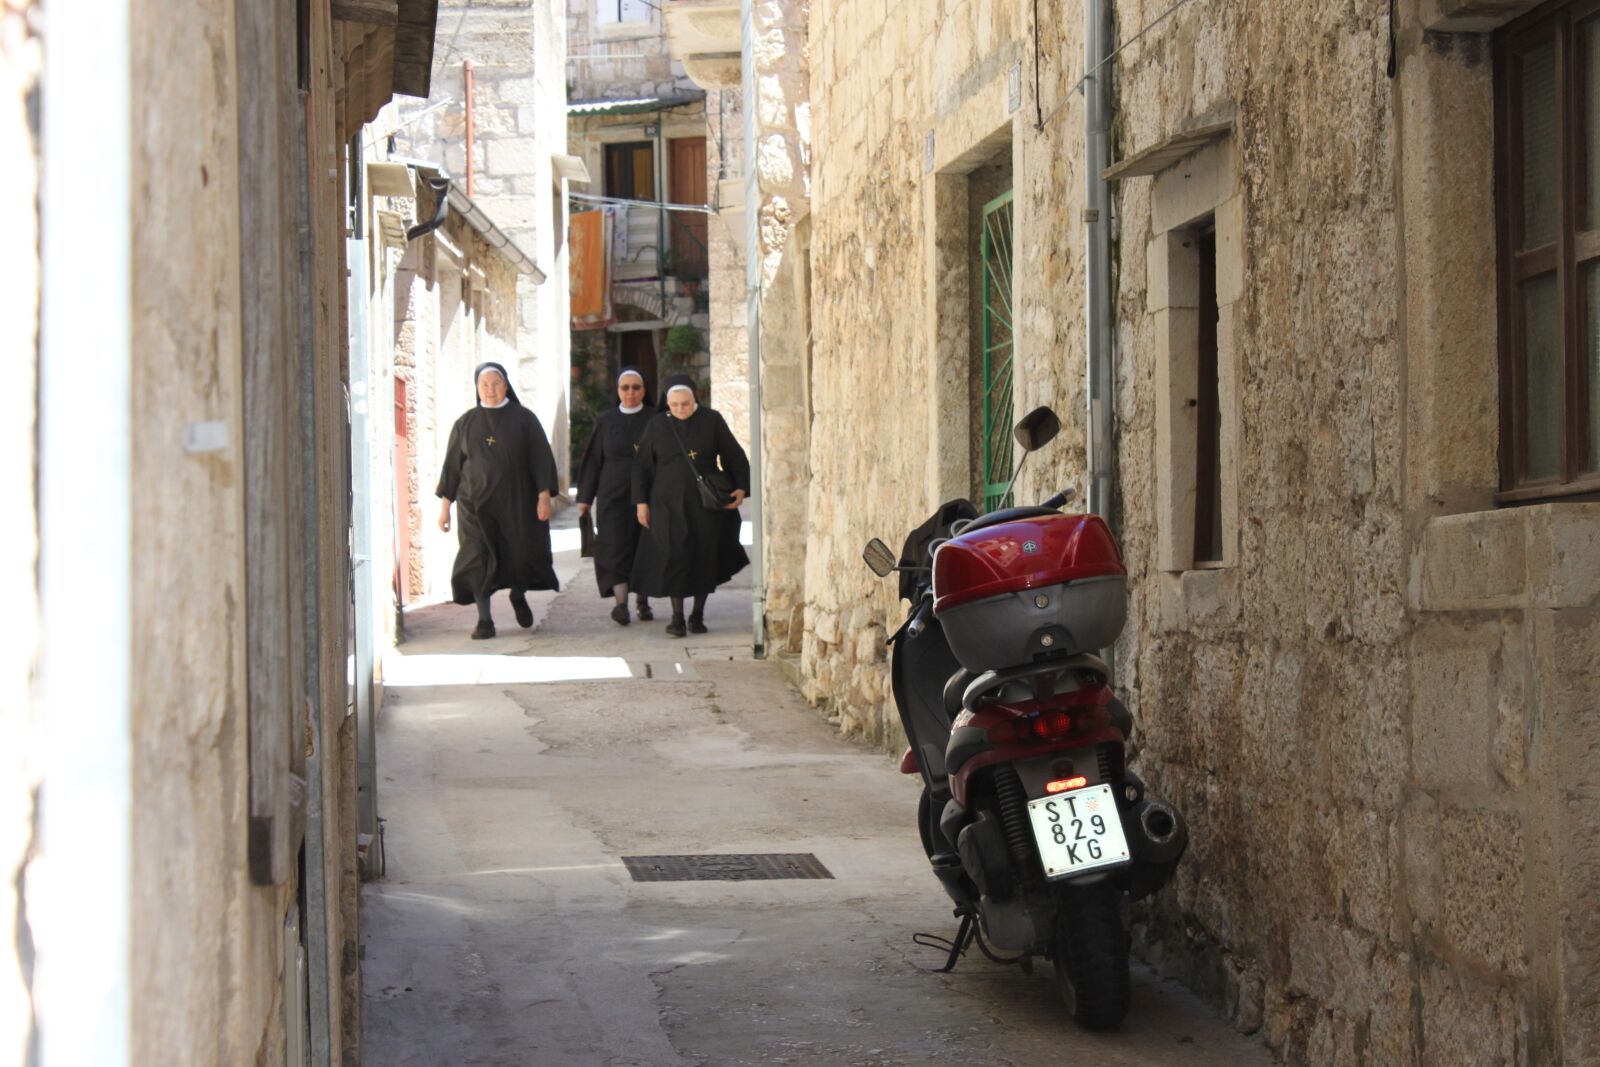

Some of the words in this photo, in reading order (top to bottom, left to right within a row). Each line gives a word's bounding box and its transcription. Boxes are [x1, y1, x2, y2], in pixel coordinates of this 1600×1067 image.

[1045, 796, 1077, 822] ST
[1051, 814, 1106, 844] 829
[1066, 839, 1102, 865] KG
